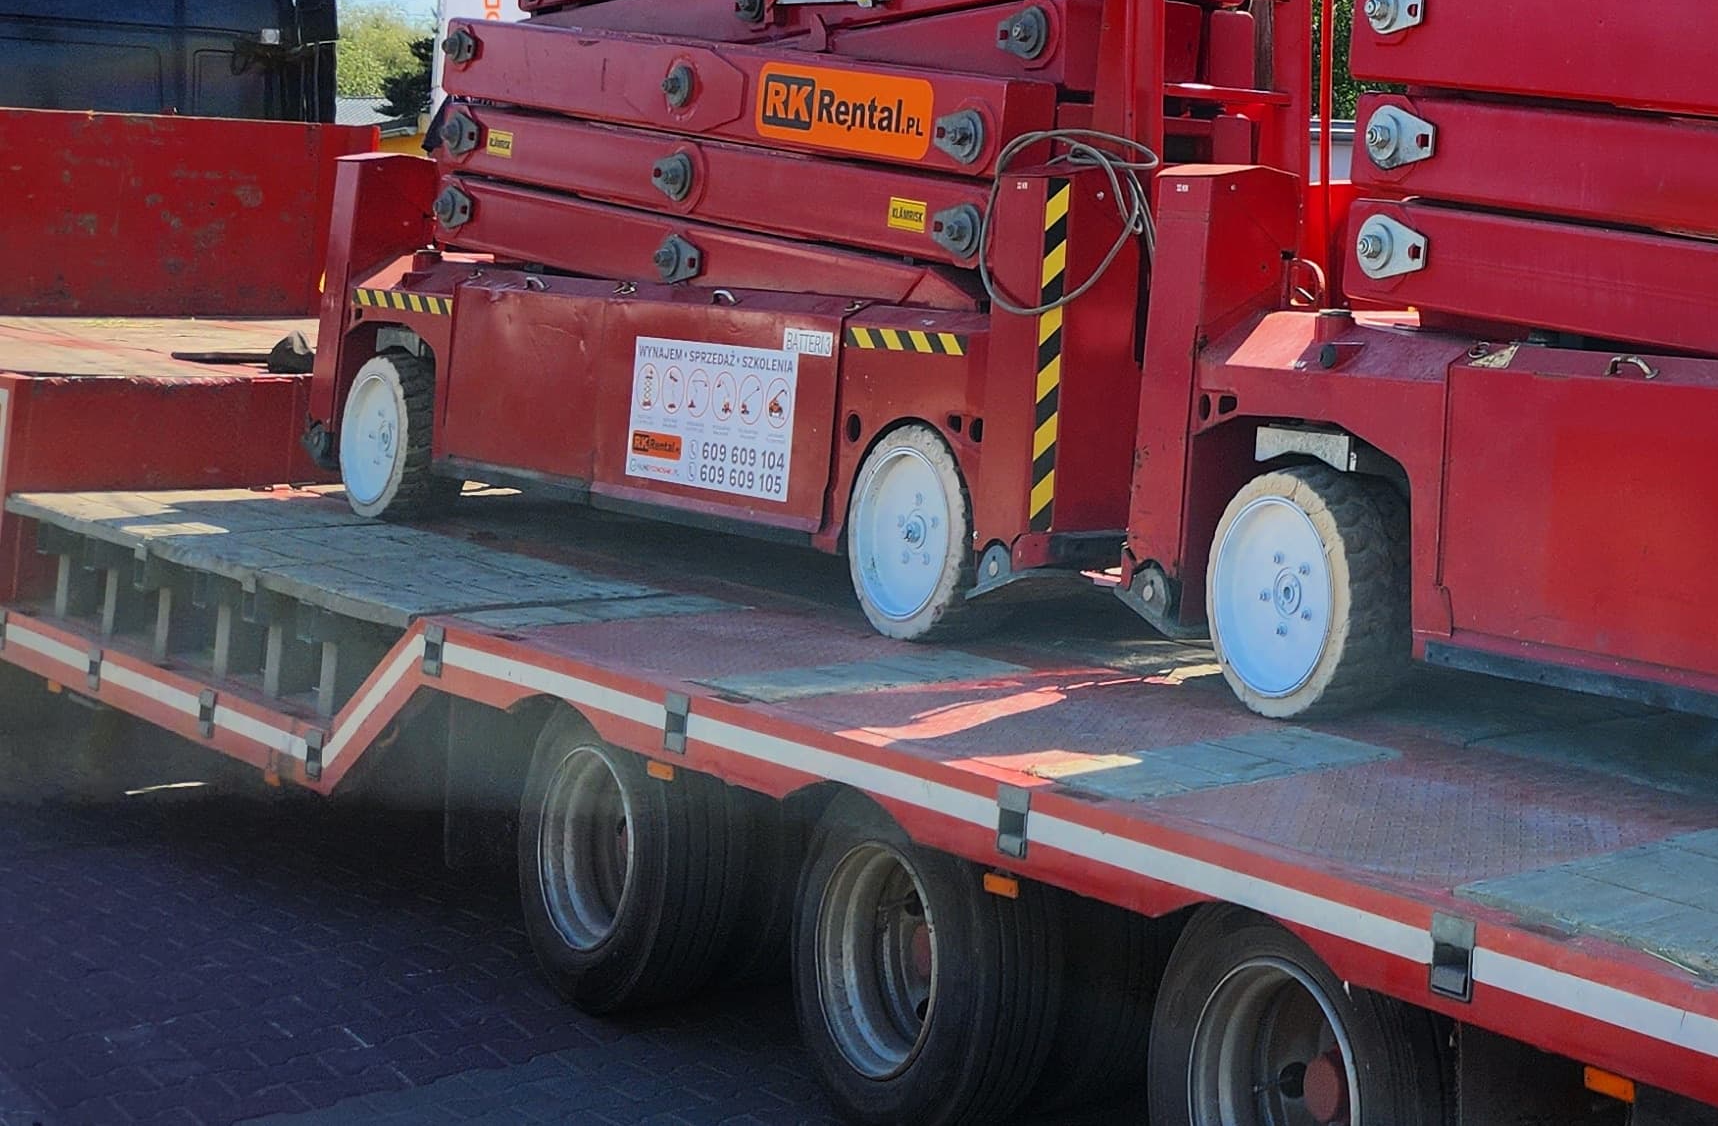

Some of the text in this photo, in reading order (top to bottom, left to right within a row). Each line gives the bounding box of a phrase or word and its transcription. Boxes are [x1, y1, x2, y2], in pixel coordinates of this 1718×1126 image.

[766, 81, 924, 137] RK Rental.PL
[638, 345, 794, 372] WYNAJEM SPRZEDAŻ SZKOLENIA
[702, 442, 785, 472] 609 609 104
[700, 465, 725, 484] 609
[729, 469, 754, 489] 609
[759, 473, 782, 494] 105
